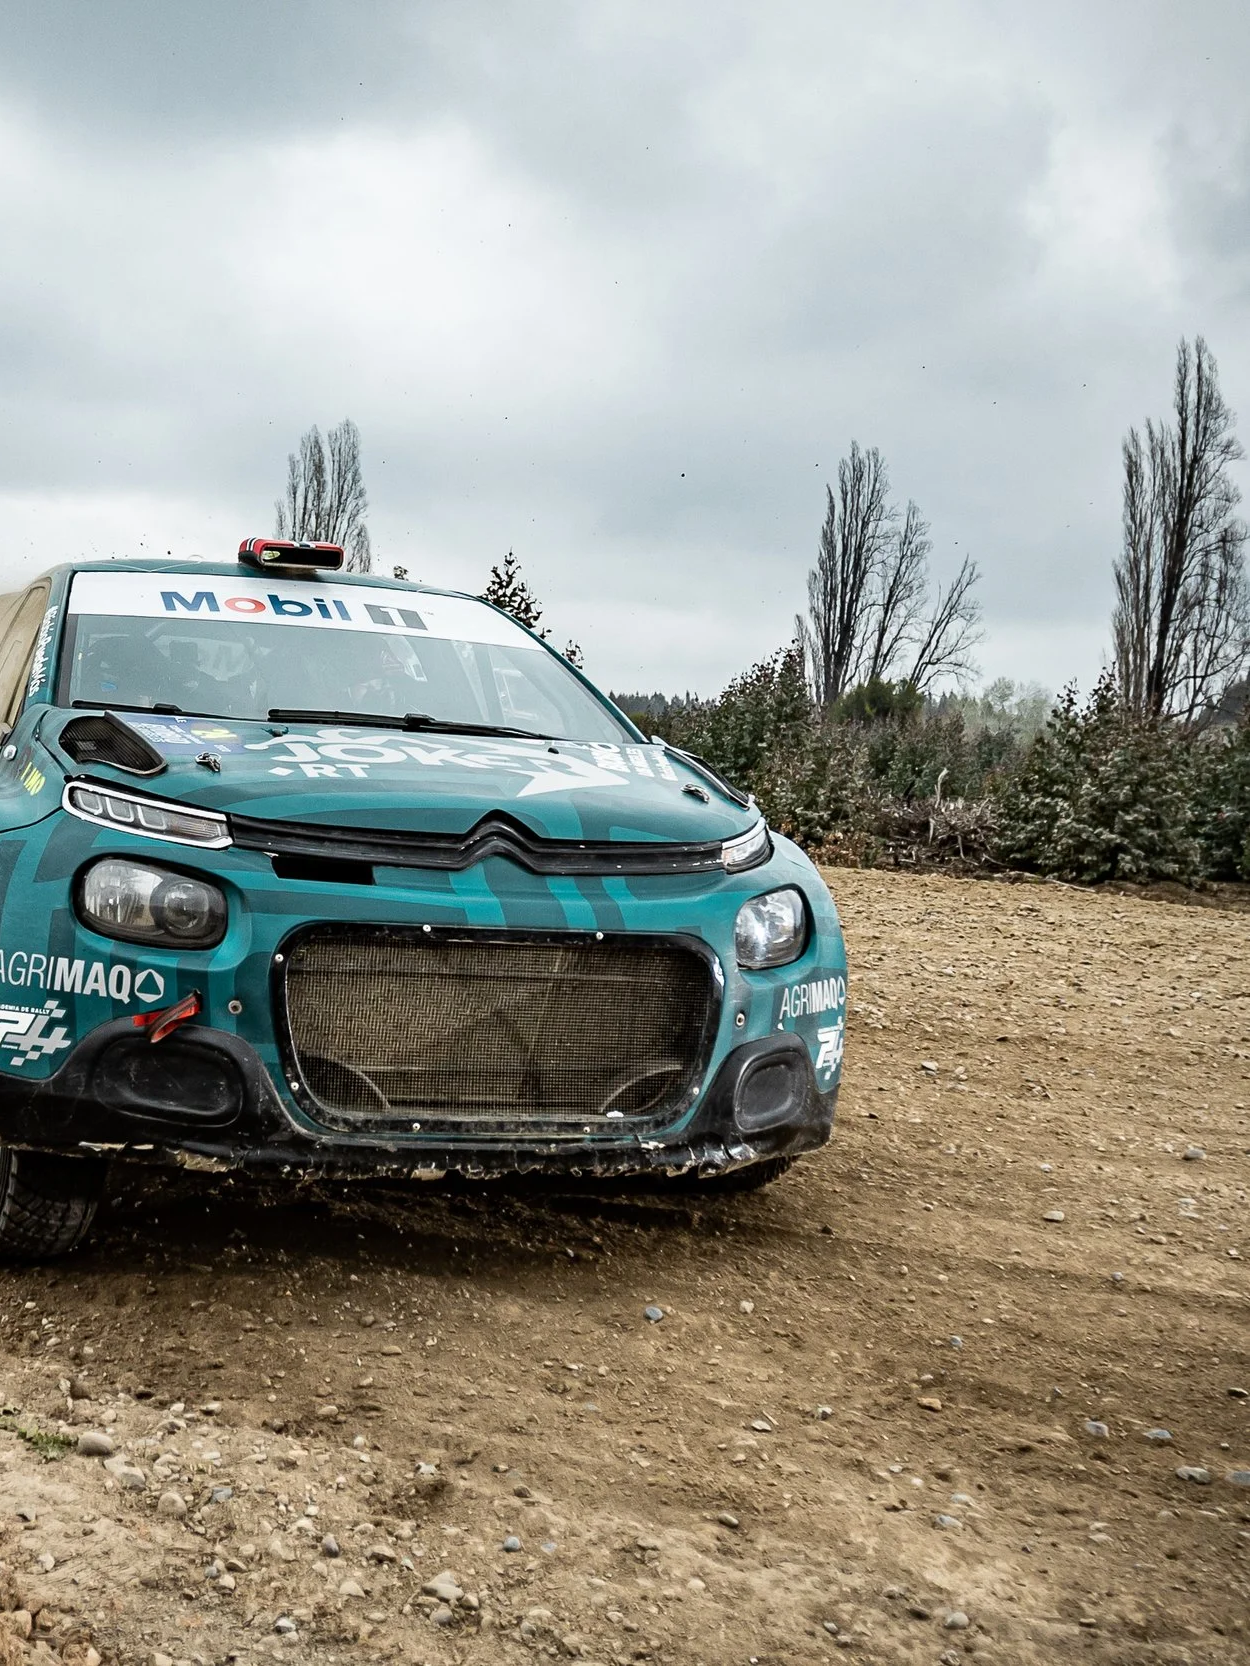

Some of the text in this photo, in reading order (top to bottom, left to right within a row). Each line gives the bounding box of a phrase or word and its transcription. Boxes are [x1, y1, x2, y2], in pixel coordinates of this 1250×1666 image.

[160, 590, 352, 621] Mobil
[270, 741, 630, 798] JOKER
[299, 763, 369, 778] RT
[30, 1007, 50, 1015] RALLY
[779, 977, 838, 1020] AGRIMAQ
